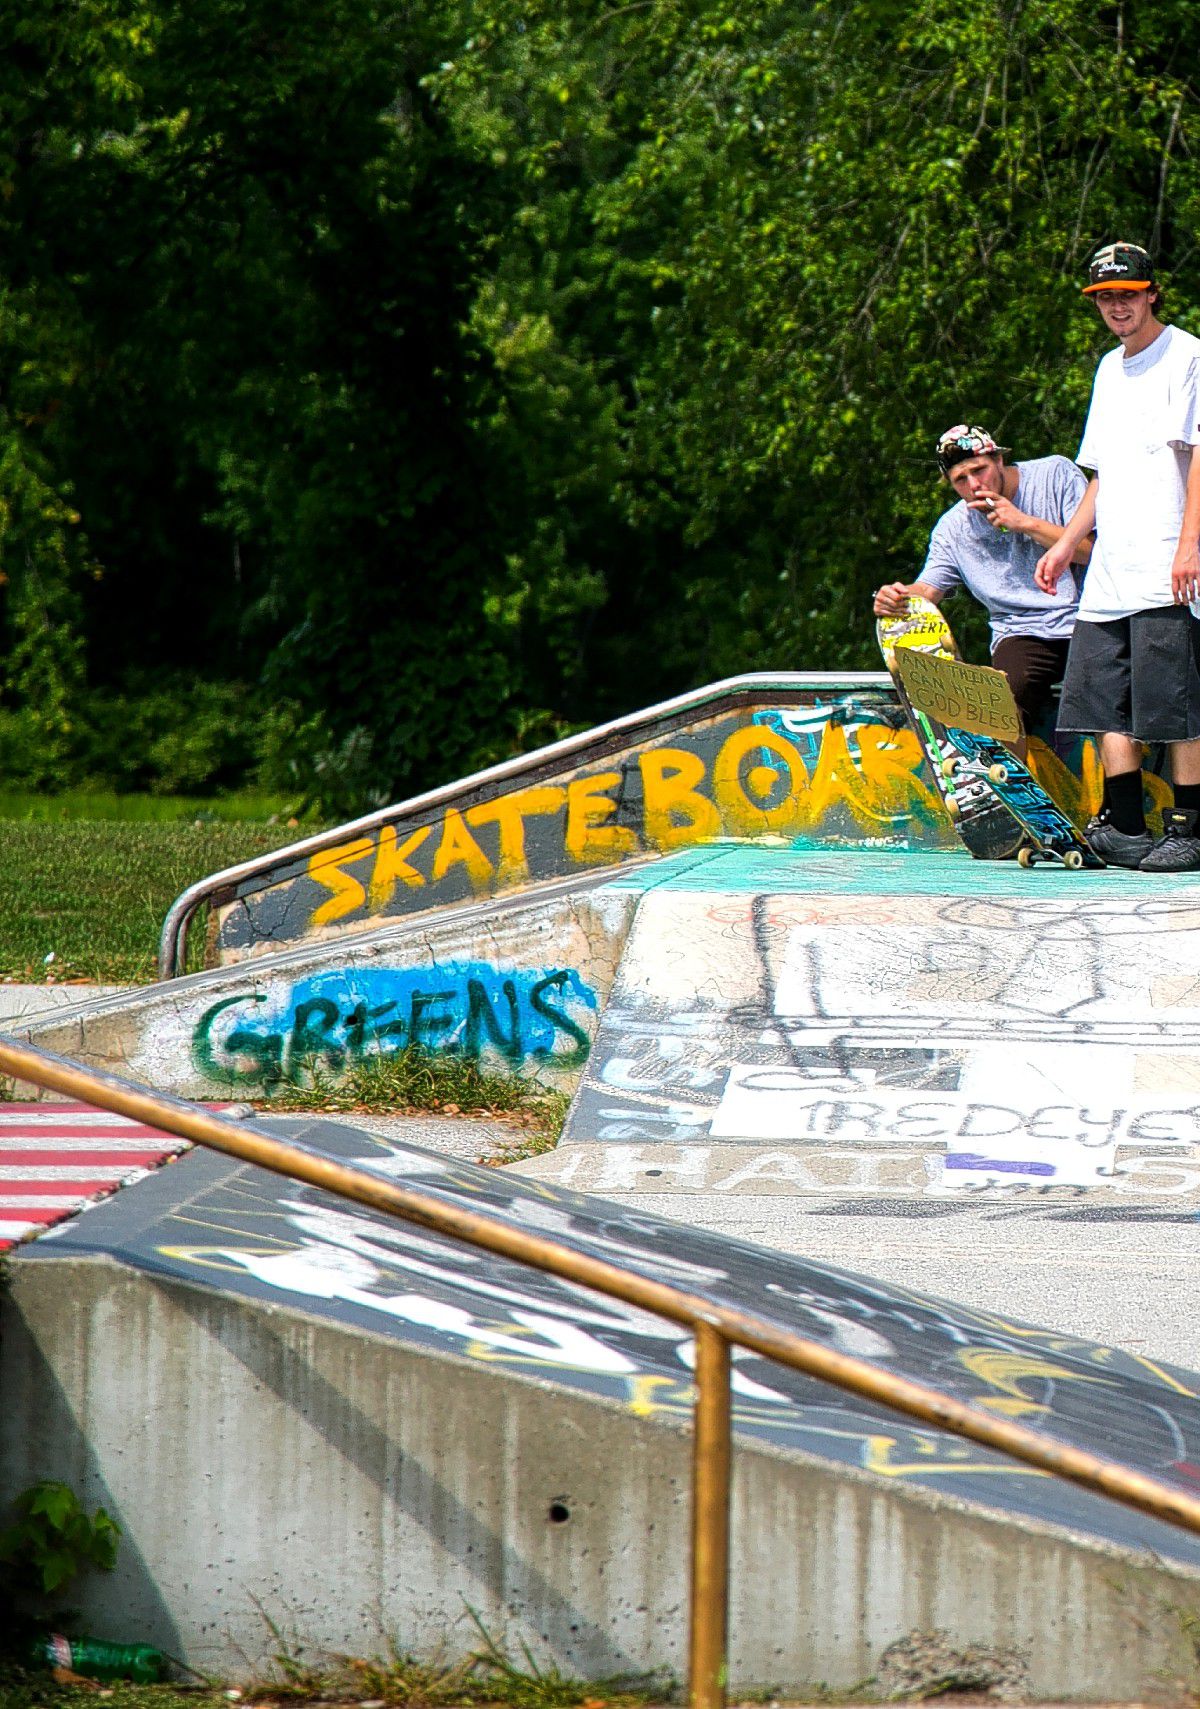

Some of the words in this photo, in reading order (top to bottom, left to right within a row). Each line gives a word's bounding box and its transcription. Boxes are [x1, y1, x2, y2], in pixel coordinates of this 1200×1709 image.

[902, 653, 940, 672] ANY
[949, 665, 1004, 689] THING
[909, 670, 946, 692] CAN
[951, 682, 1001, 707] HELP
[915, 687, 961, 717] GOD
[966, 703, 1020, 731] BLESS
[192, 970, 592, 1090] GREENS
